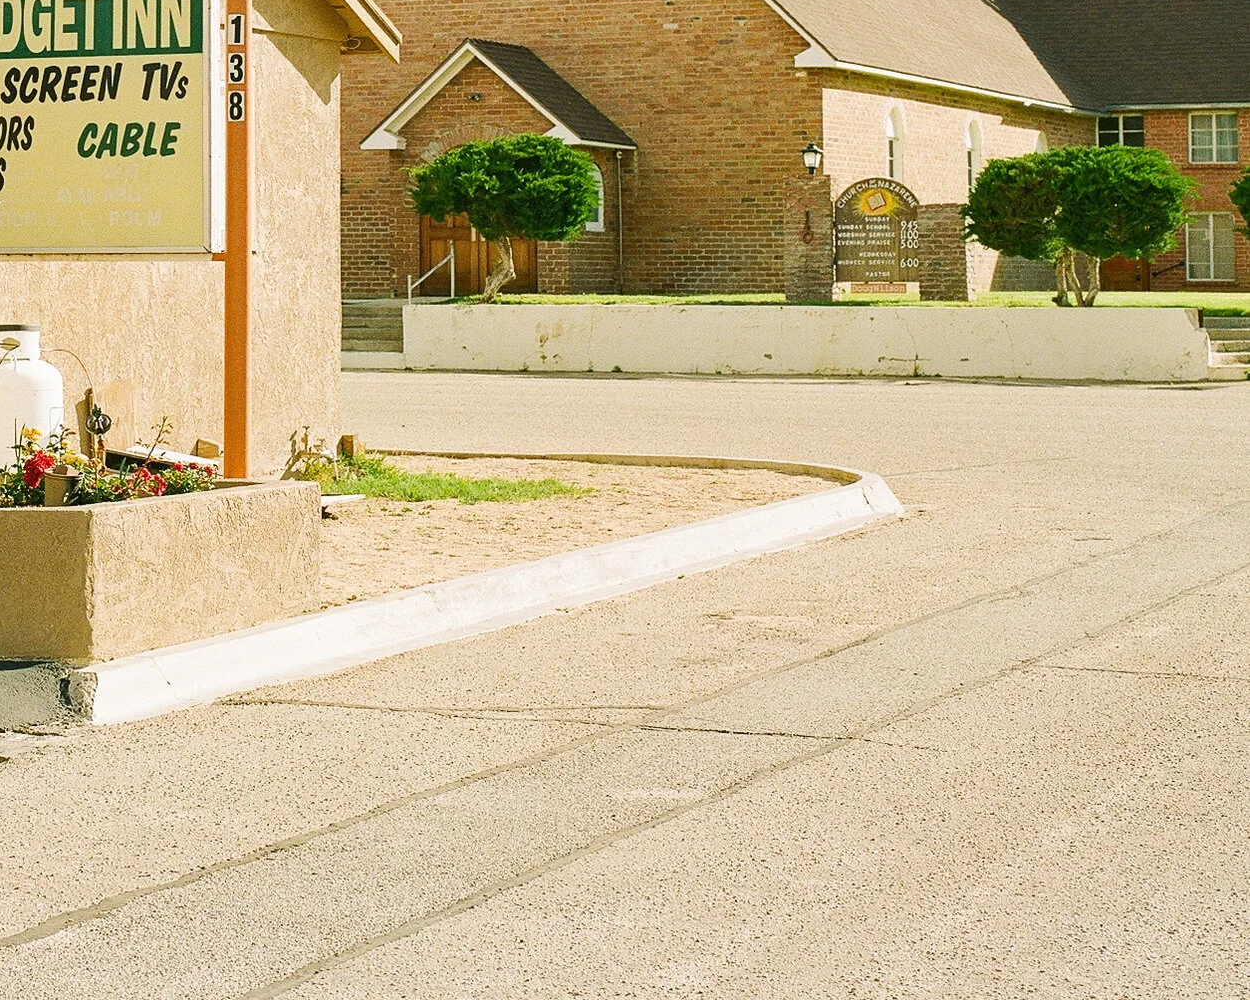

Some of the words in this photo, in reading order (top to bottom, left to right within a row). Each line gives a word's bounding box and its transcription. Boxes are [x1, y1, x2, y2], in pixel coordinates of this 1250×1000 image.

[1, 63, 122, 104] SCREEN
[142, 62, 188, 100] TVs
[78, 122, 180, 158] CABLE
[838, 183, 868, 208] CHURCH
[878, 181, 917, 208] NAZARENE
